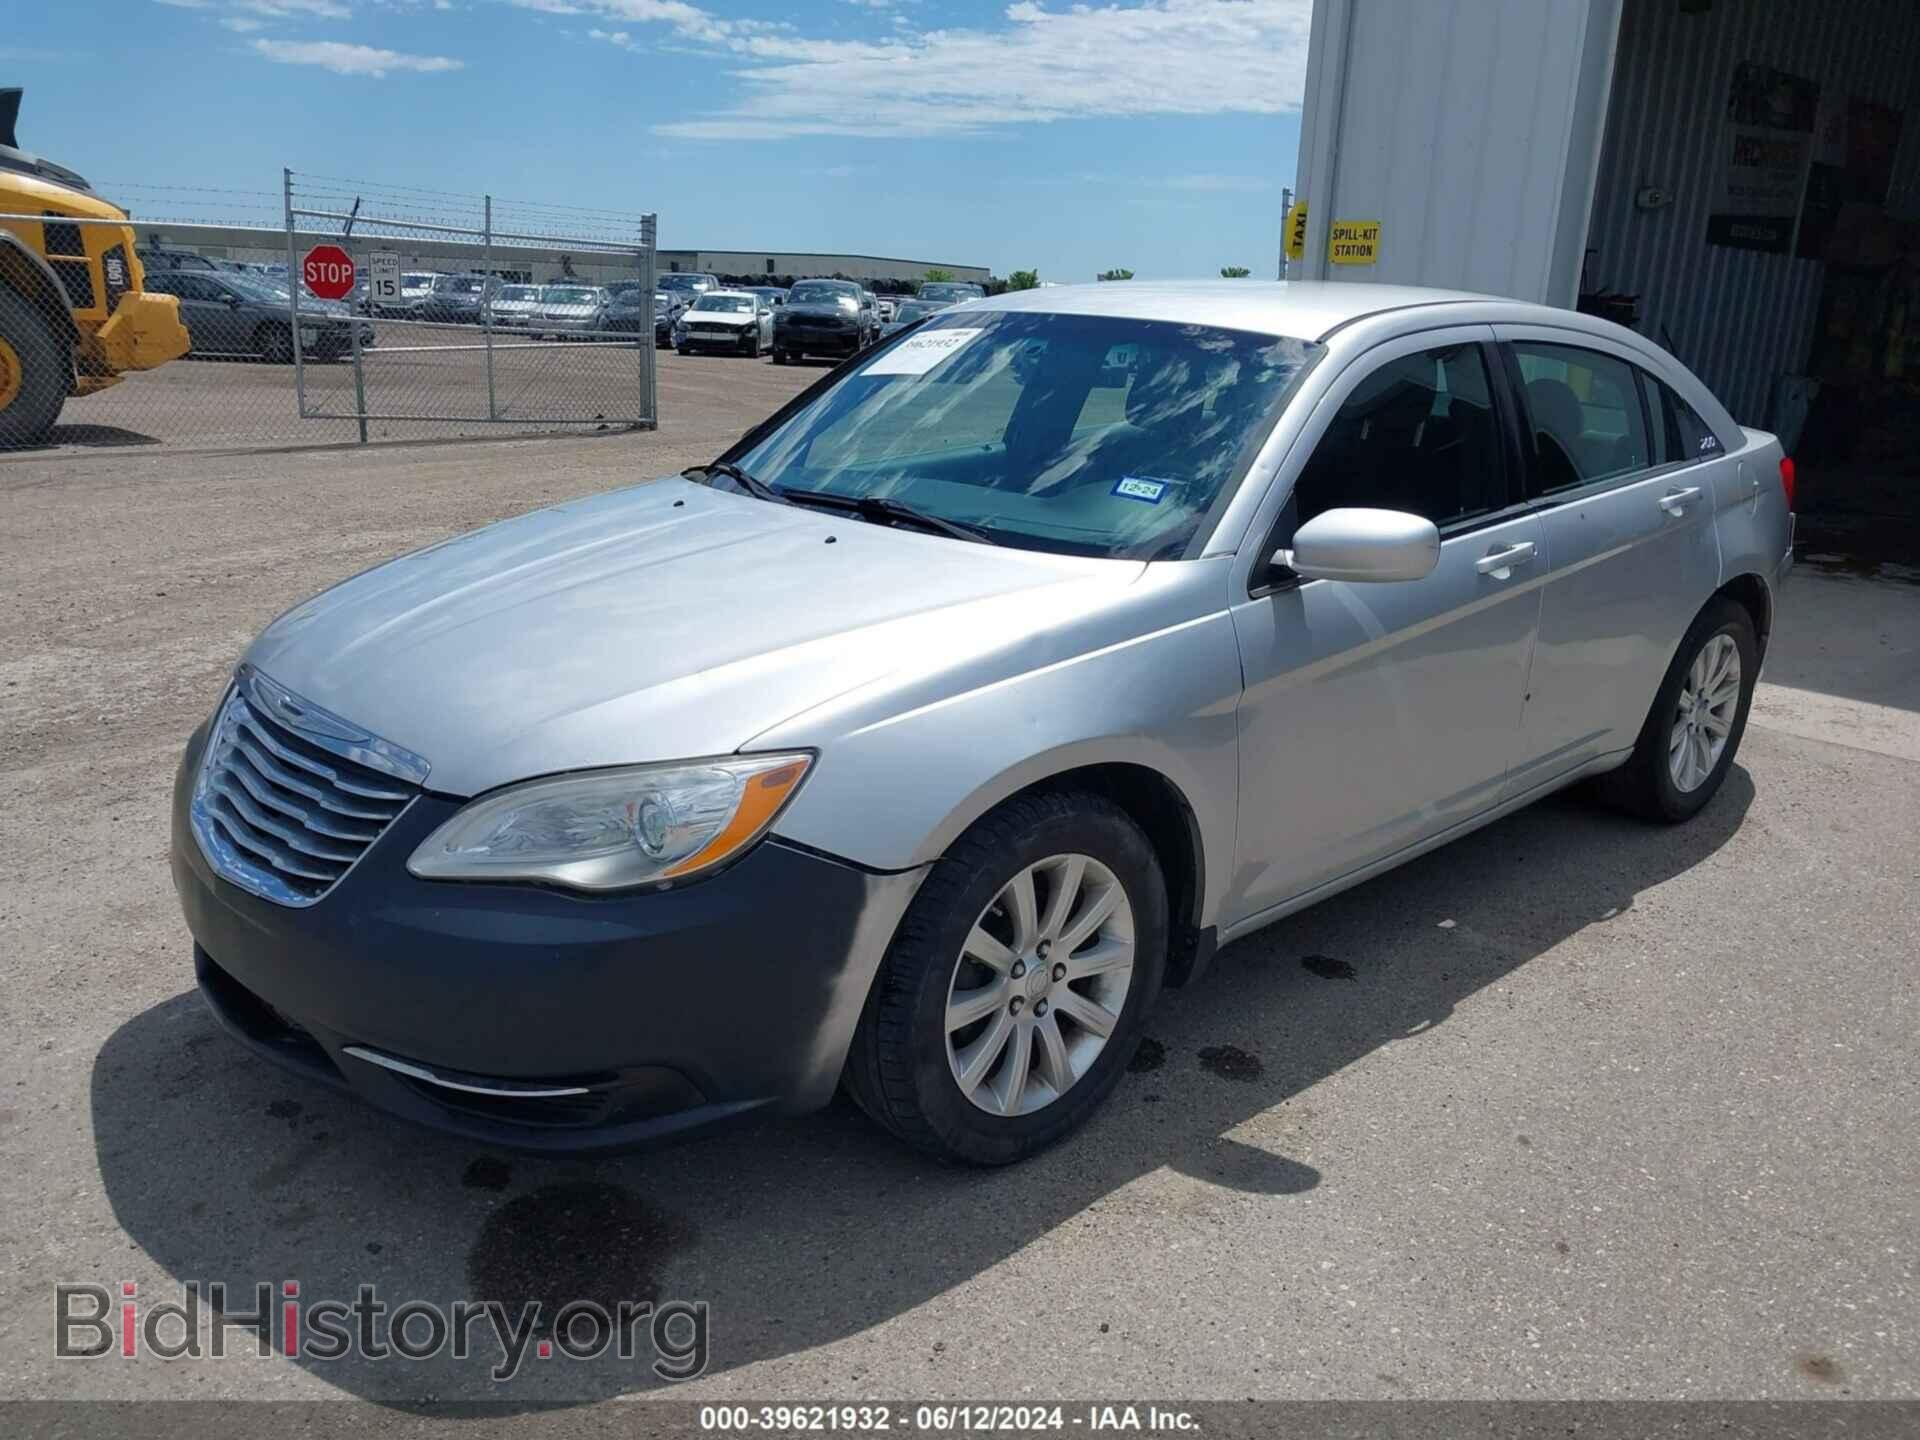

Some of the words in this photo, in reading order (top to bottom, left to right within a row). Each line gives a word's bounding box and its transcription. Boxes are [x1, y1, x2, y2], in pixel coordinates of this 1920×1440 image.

[1293, 213, 1306, 246] TAXI
[1333, 228, 1378, 240] SPILL-KIT
[1335, 245, 1373, 256] STATION
[107, 259, 124, 285] L90H
[306, 262, 352, 283] STOP
[376, 280, 395, 296] 15
